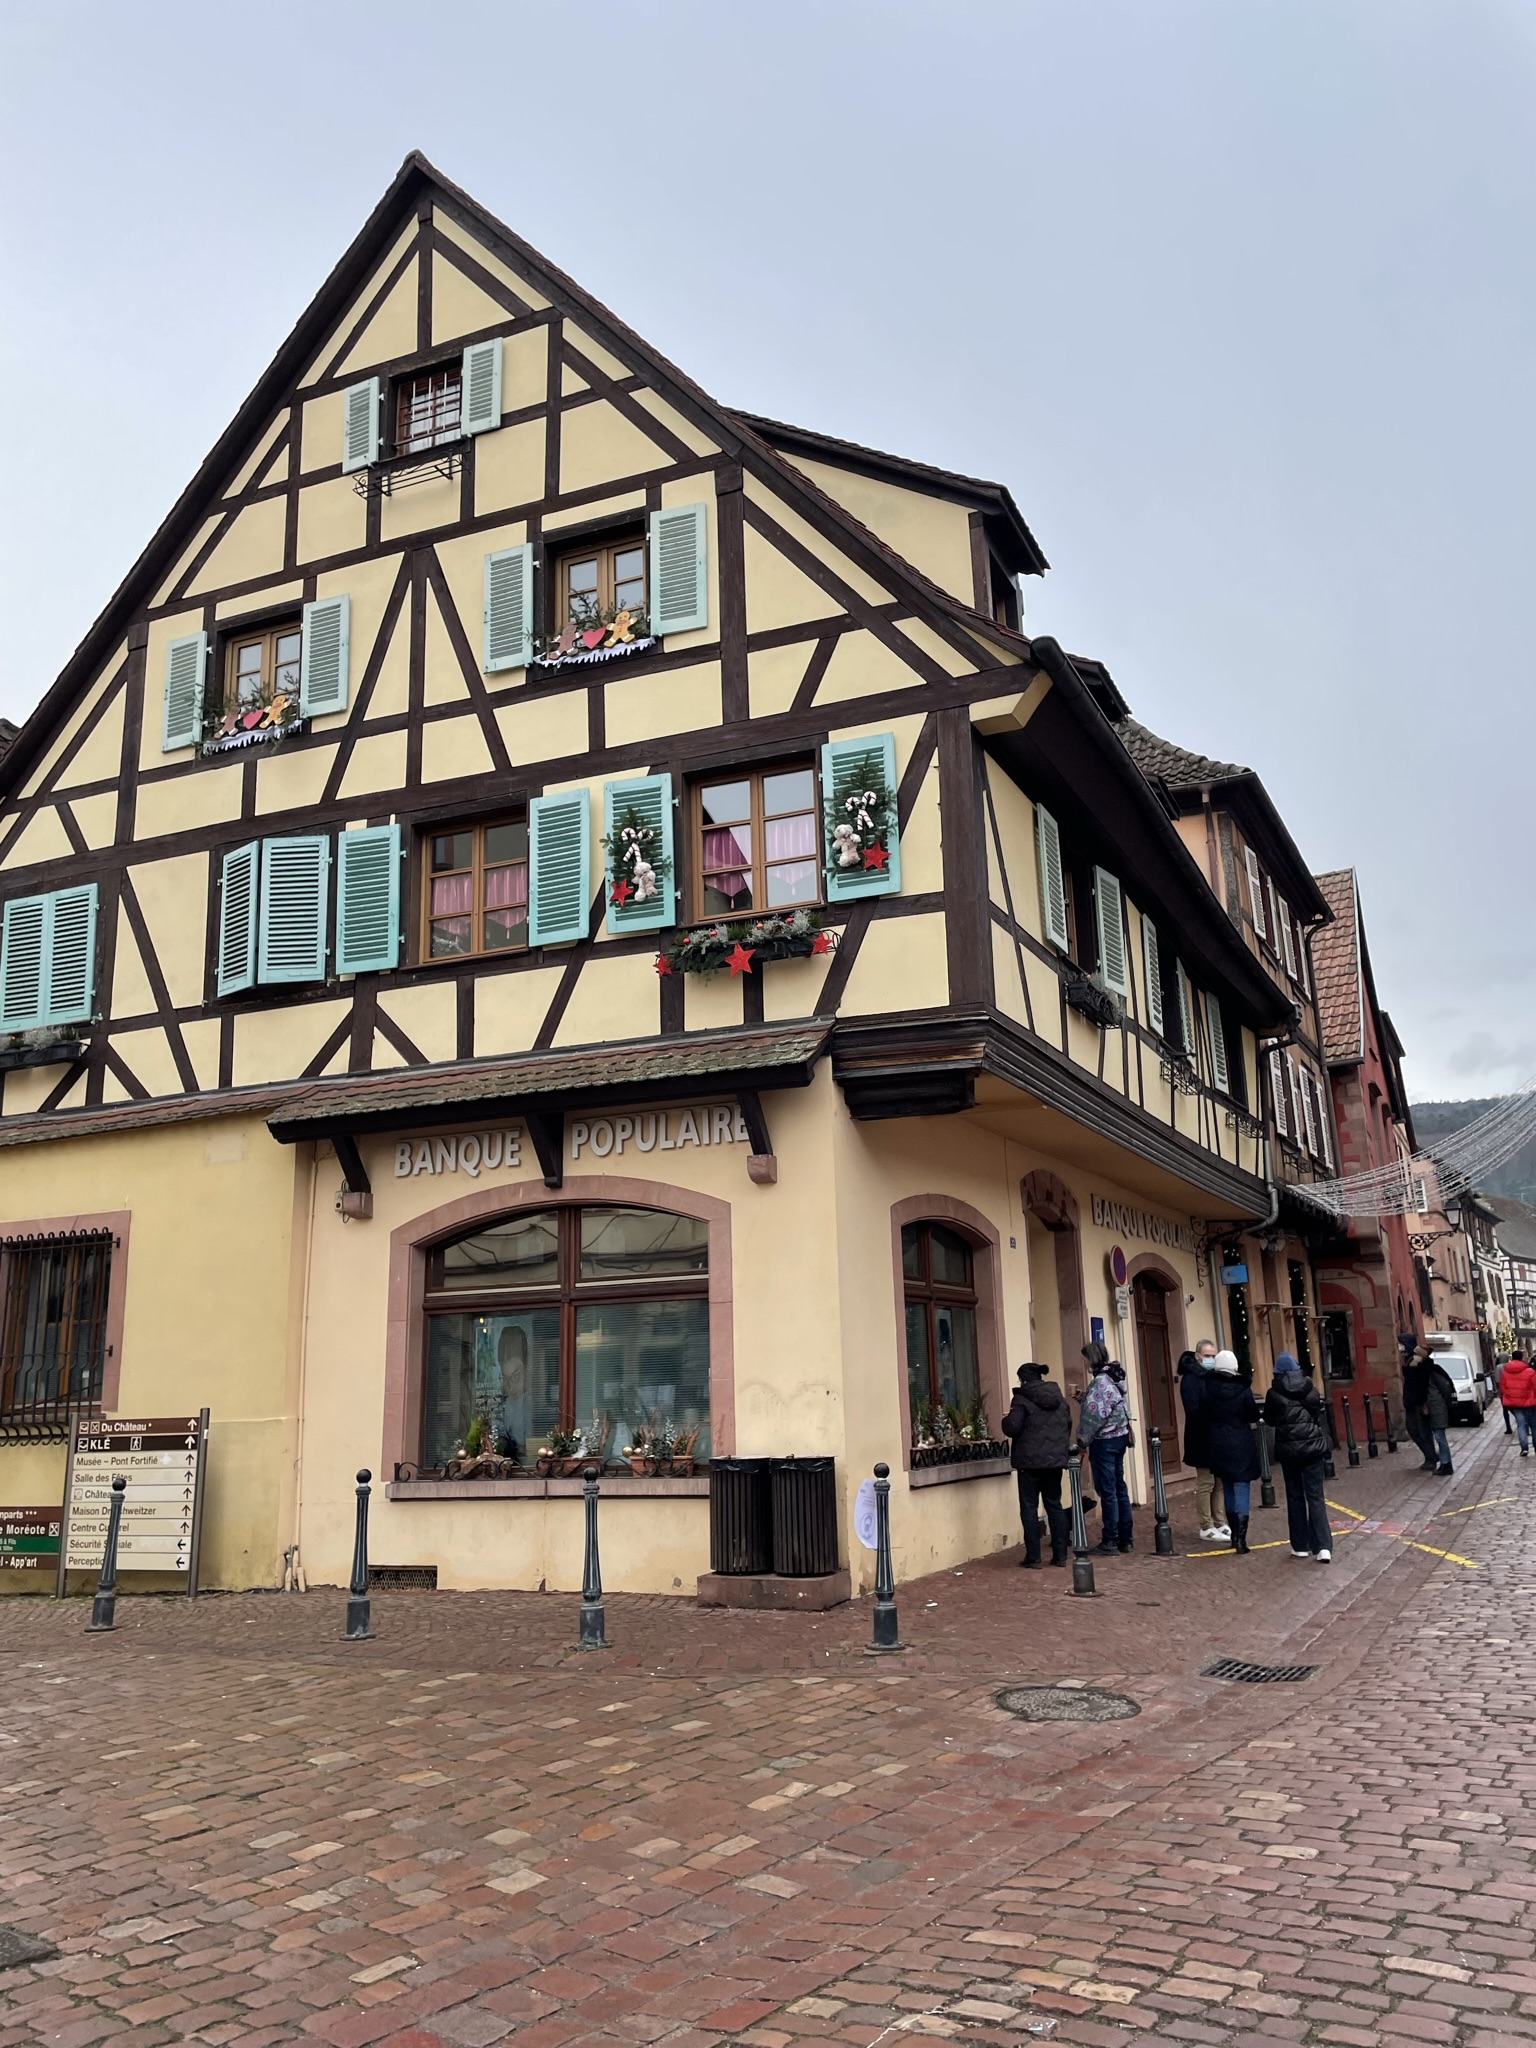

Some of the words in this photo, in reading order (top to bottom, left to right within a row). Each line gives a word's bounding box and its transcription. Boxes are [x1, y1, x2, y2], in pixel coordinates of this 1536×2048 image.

[394, 1130, 521, 1178] BANQUE
[571, 1105, 750, 1159] POPULAIRE
[101, 1422, 113, 1432] Du
[113, 1422, 147, 1432] Château
[90, 1436, 111, 1450] KLÉ
[76, 1457, 102, 1466] Musée
[111, 1457, 129, 1466] Pont
[130, 1456, 158, 1465] Fortifié
[75, 1473, 94, 1483] Salle
[95, 1473, 110, 1482] des
[84, 1489, 113, 1499] Châtea
[72, 1506, 99, 1515] Maison
[119, 1506, 156, 1515] hweitzer
[6, 1523, 46, 1535] Moréote
[71, 1523, 97, 1532] Centre
[98, 1523, 130, 1532] Curel
[70, 1539, 102, 1549] Sécurité
[103, 1540, 132, 1549] Siale
[10, 1556, 37, 1569] App'art
[68, 1556, 105, 1567] Perceptio
